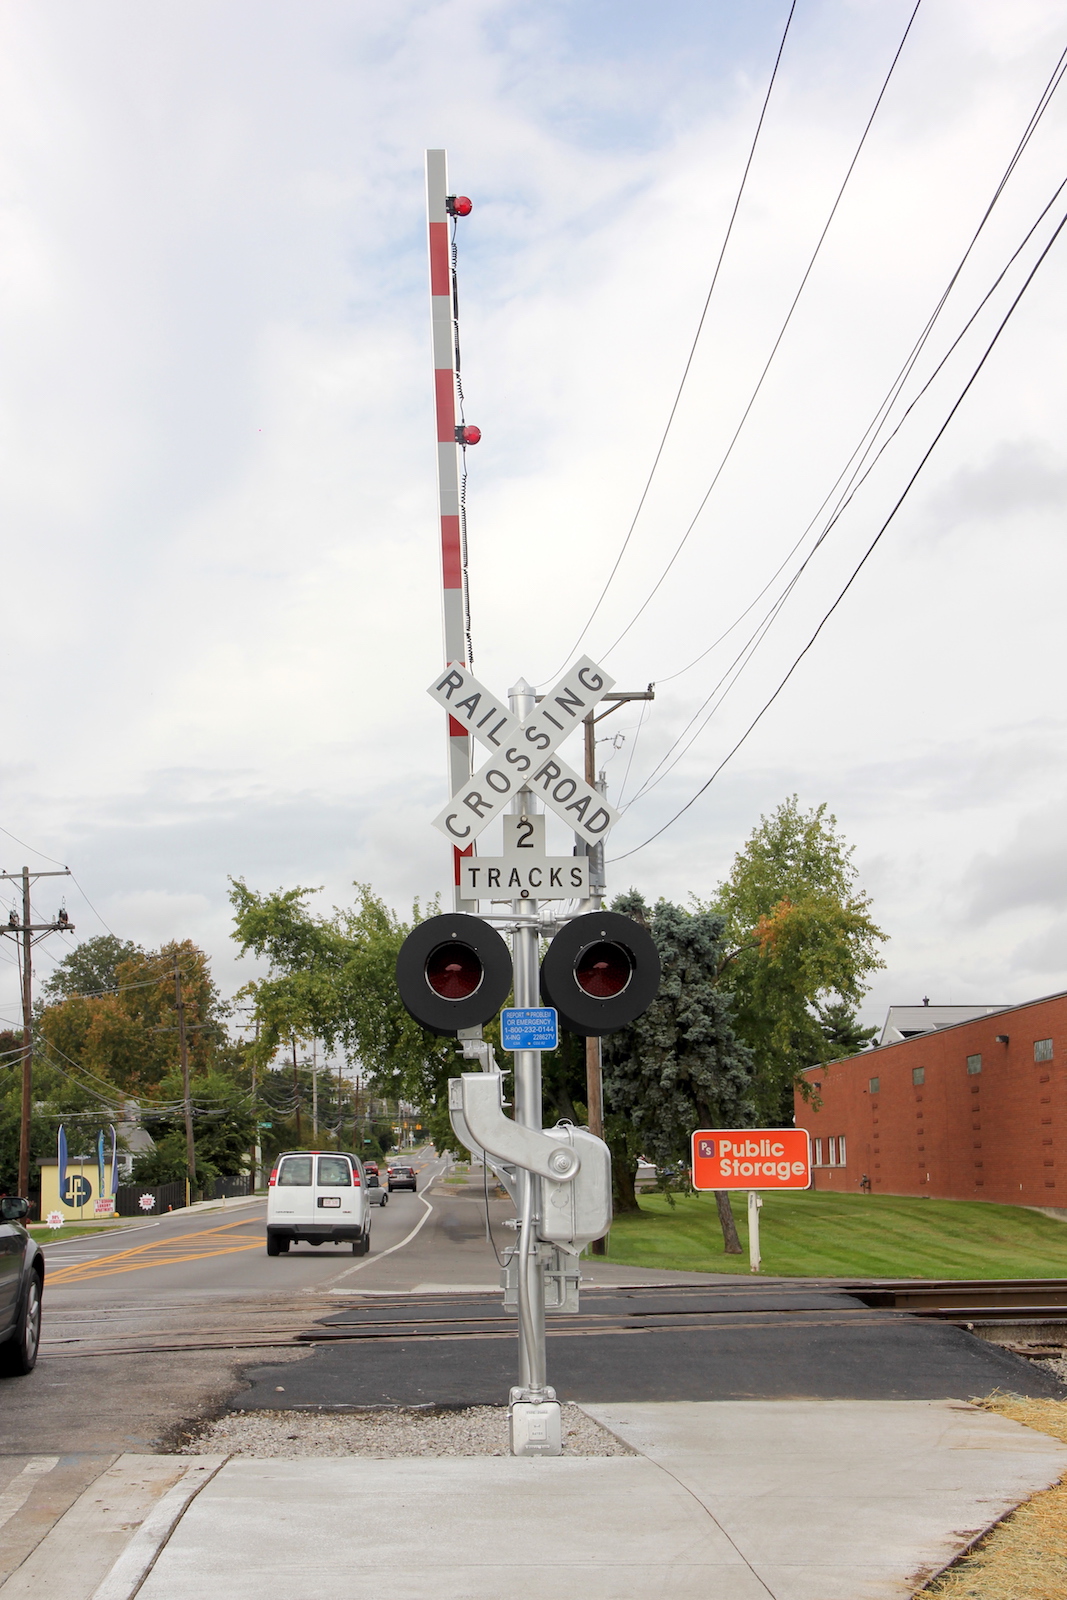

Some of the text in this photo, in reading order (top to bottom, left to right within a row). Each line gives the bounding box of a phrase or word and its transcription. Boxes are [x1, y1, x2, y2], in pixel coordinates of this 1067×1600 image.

[436, 669, 610, 834] RAIL ROAD
[445, 667, 604, 839] CROSSING
[516, 822, 534, 848] 2
[468, 867, 583, 888] TRACKS
[719, 1139, 785, 1158] Public
[719, 1158, 806, 1181] Storage
